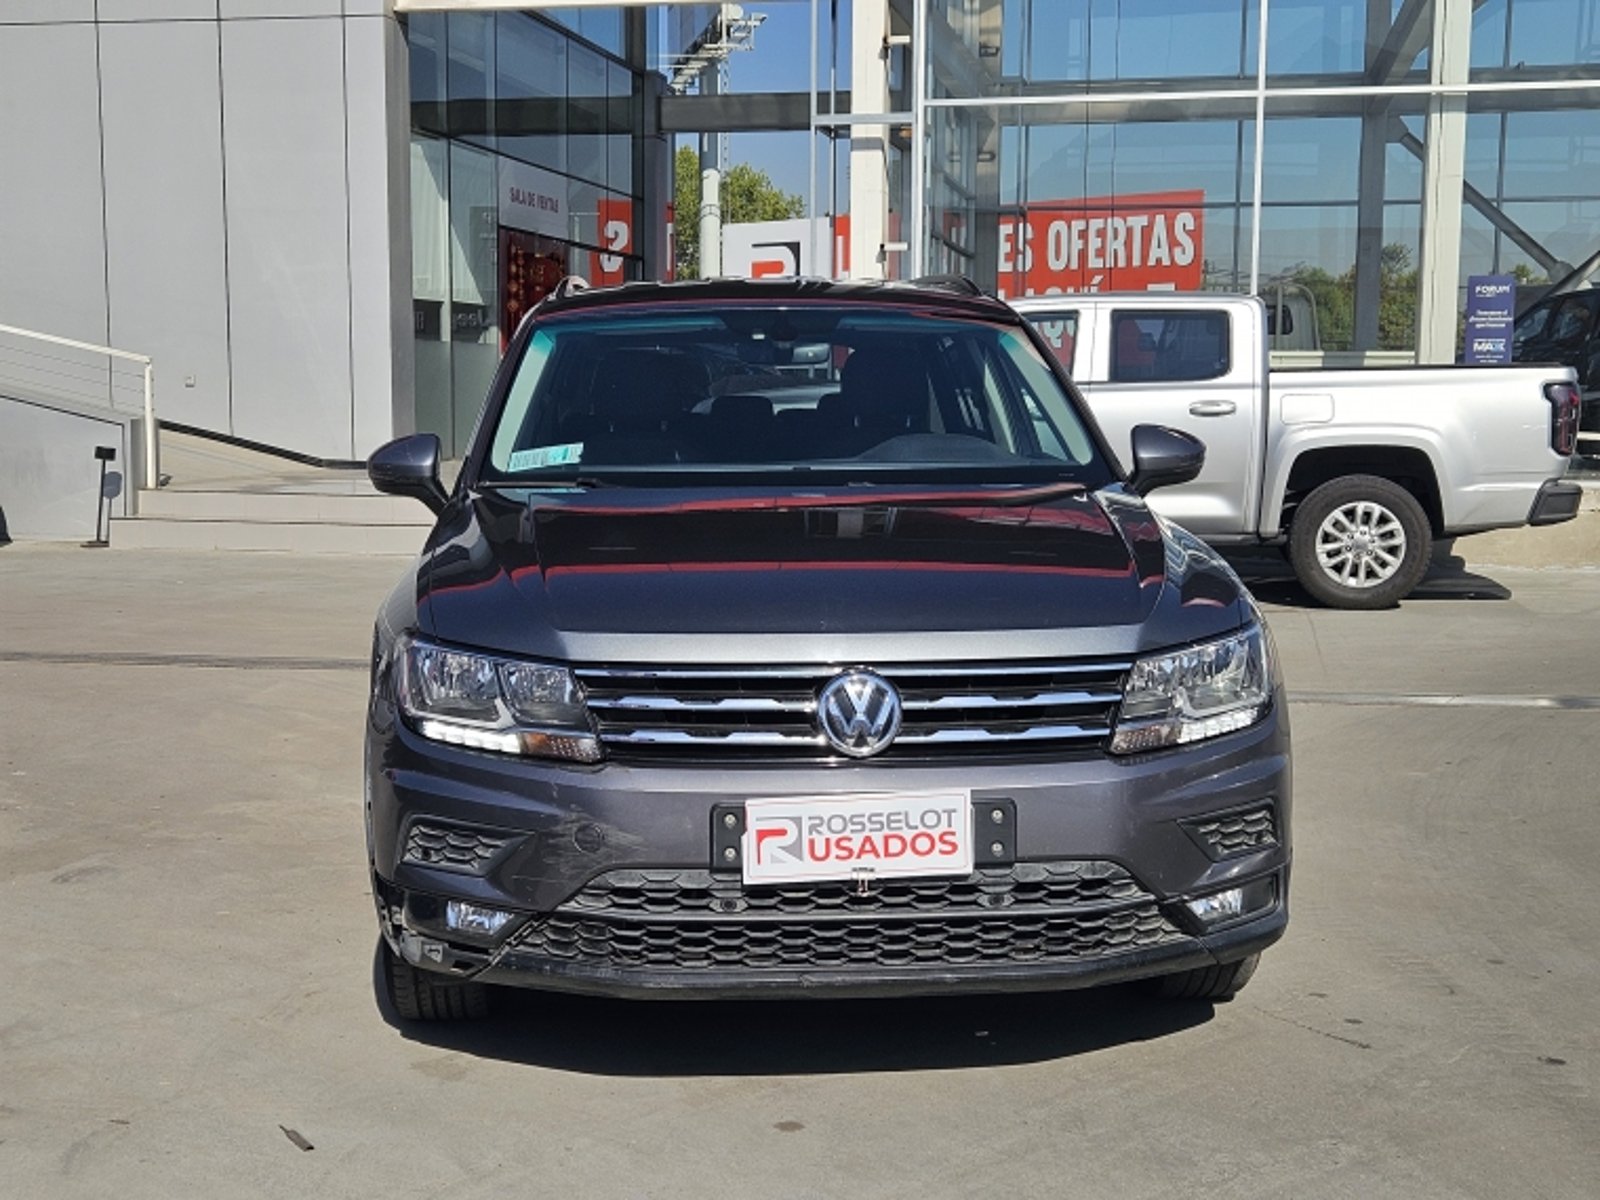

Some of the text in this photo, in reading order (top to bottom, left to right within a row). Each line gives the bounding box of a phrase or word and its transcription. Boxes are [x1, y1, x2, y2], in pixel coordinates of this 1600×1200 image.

[510, 186, 559, 213] SALA DE VENTAS
[998, 212, 1196, 272] ES OFERTAS
[1475, 285, 1510, 294] FORUM
[808, 808, 958, 836] ROSSELOT
[808, 831, 959, 863] USADOS
